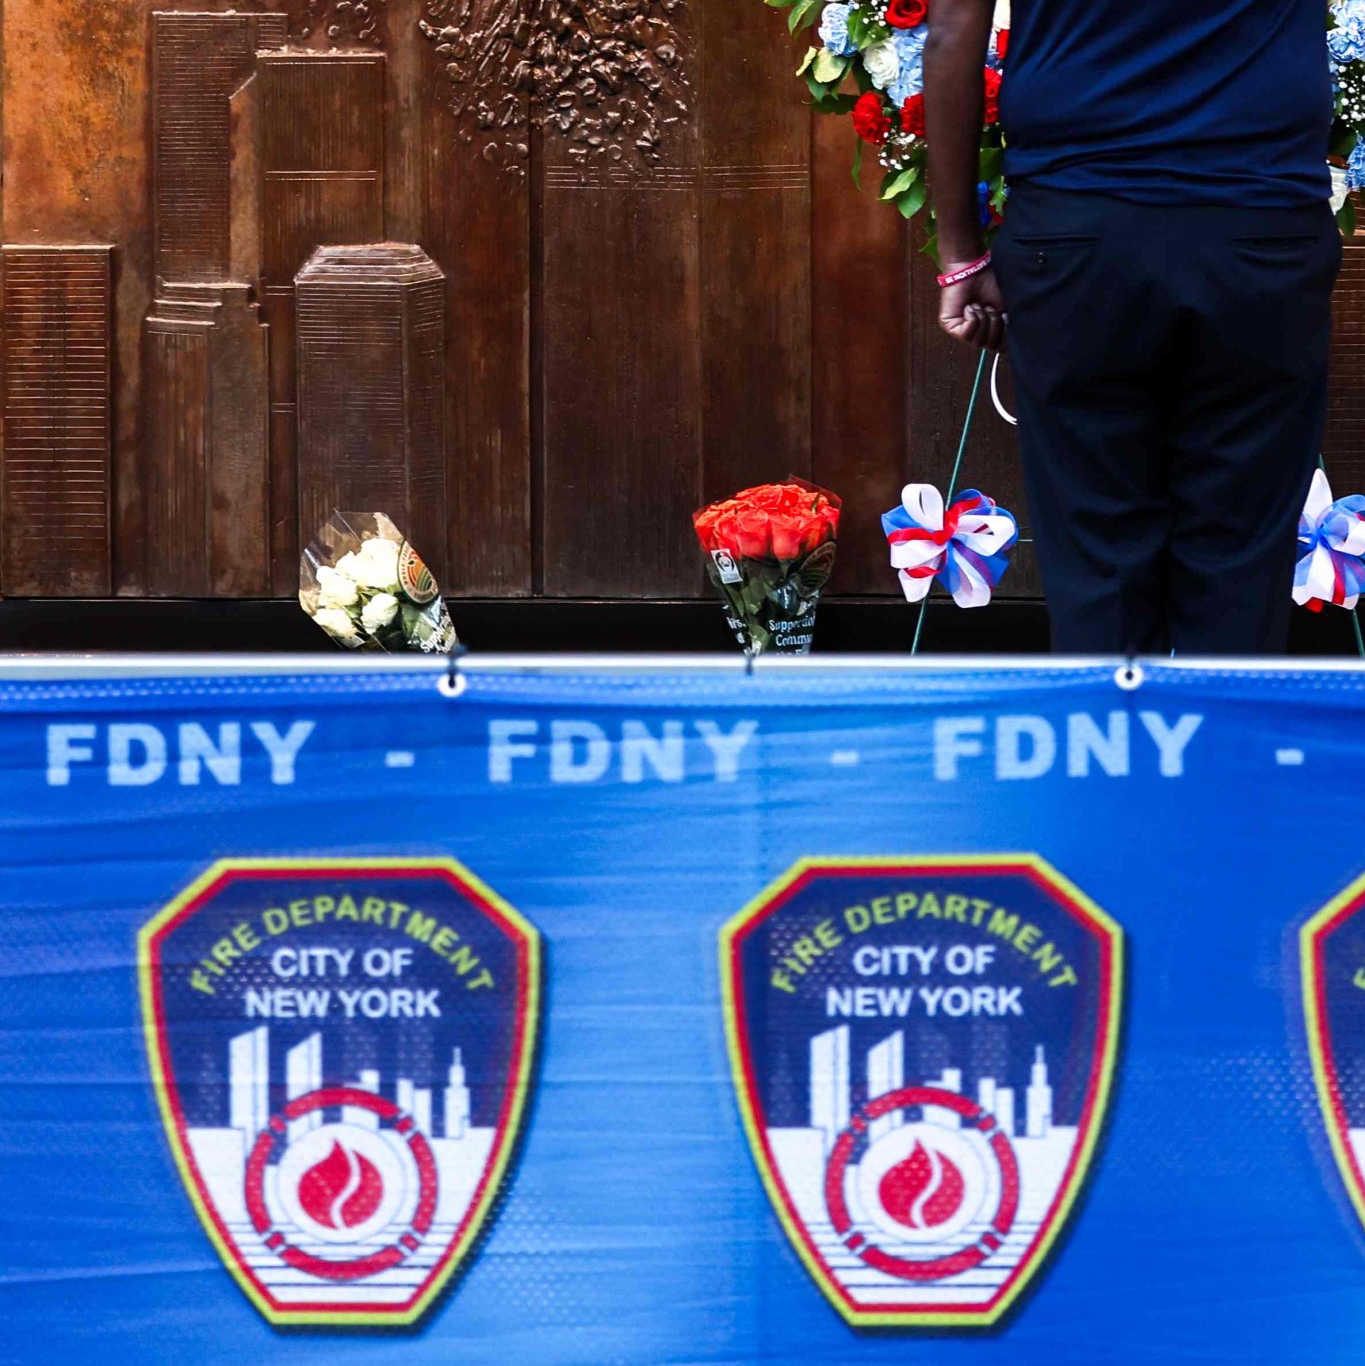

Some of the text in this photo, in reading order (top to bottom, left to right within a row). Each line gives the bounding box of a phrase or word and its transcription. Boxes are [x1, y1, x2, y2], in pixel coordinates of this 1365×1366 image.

[49, 723, 313, 785] FDNY
[489, 720, 757, 784] FDNY
[935, 714, 1203, 779] FDNY
[190, 896, 495, 995] FIRE DEPARTMENT
[770, 892, 1078, 994] FIRE DEPARTMENT
[271, 947, 414, 977] CITY OF
[853, 944, 996, 976] CITY OF
[245, 988, 441, 1018] NEW YORK
[826, 986, 1023, 1017] NEW YORK
